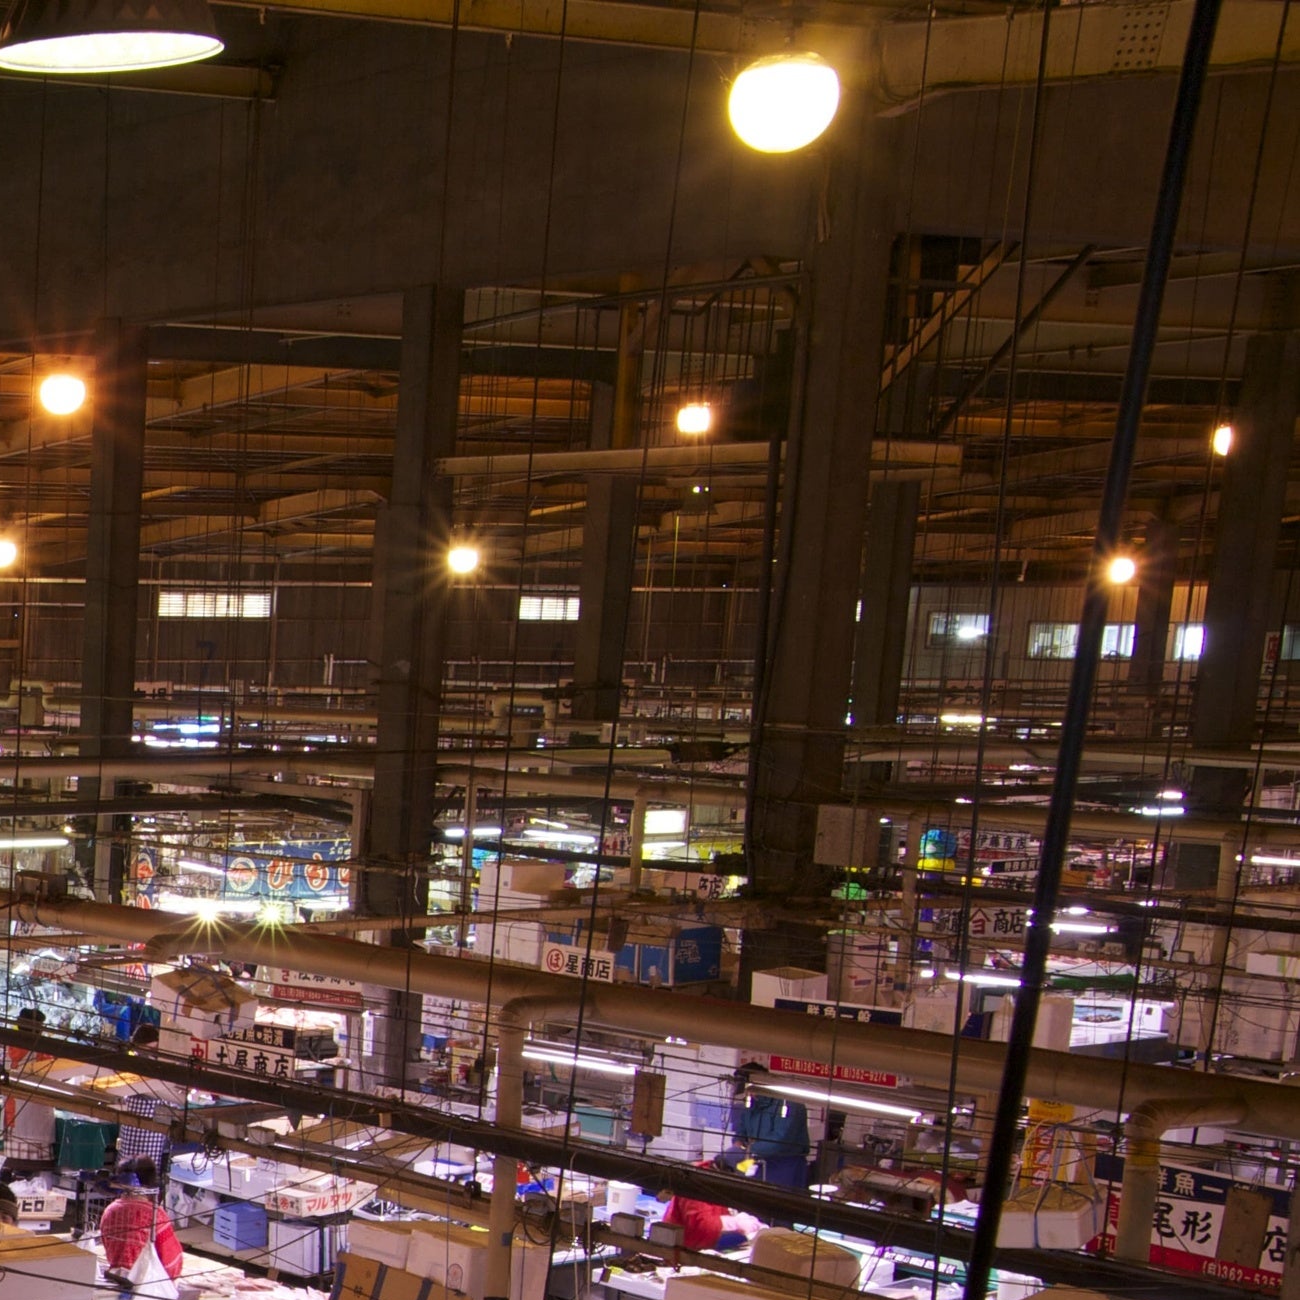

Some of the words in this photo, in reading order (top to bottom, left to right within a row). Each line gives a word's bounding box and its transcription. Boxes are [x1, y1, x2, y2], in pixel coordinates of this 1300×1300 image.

[993, 908, 1025, 935] 商店
[565, 953, 611, 981] 星商店
[216, 1045, 290, 1079] 土屋商店
